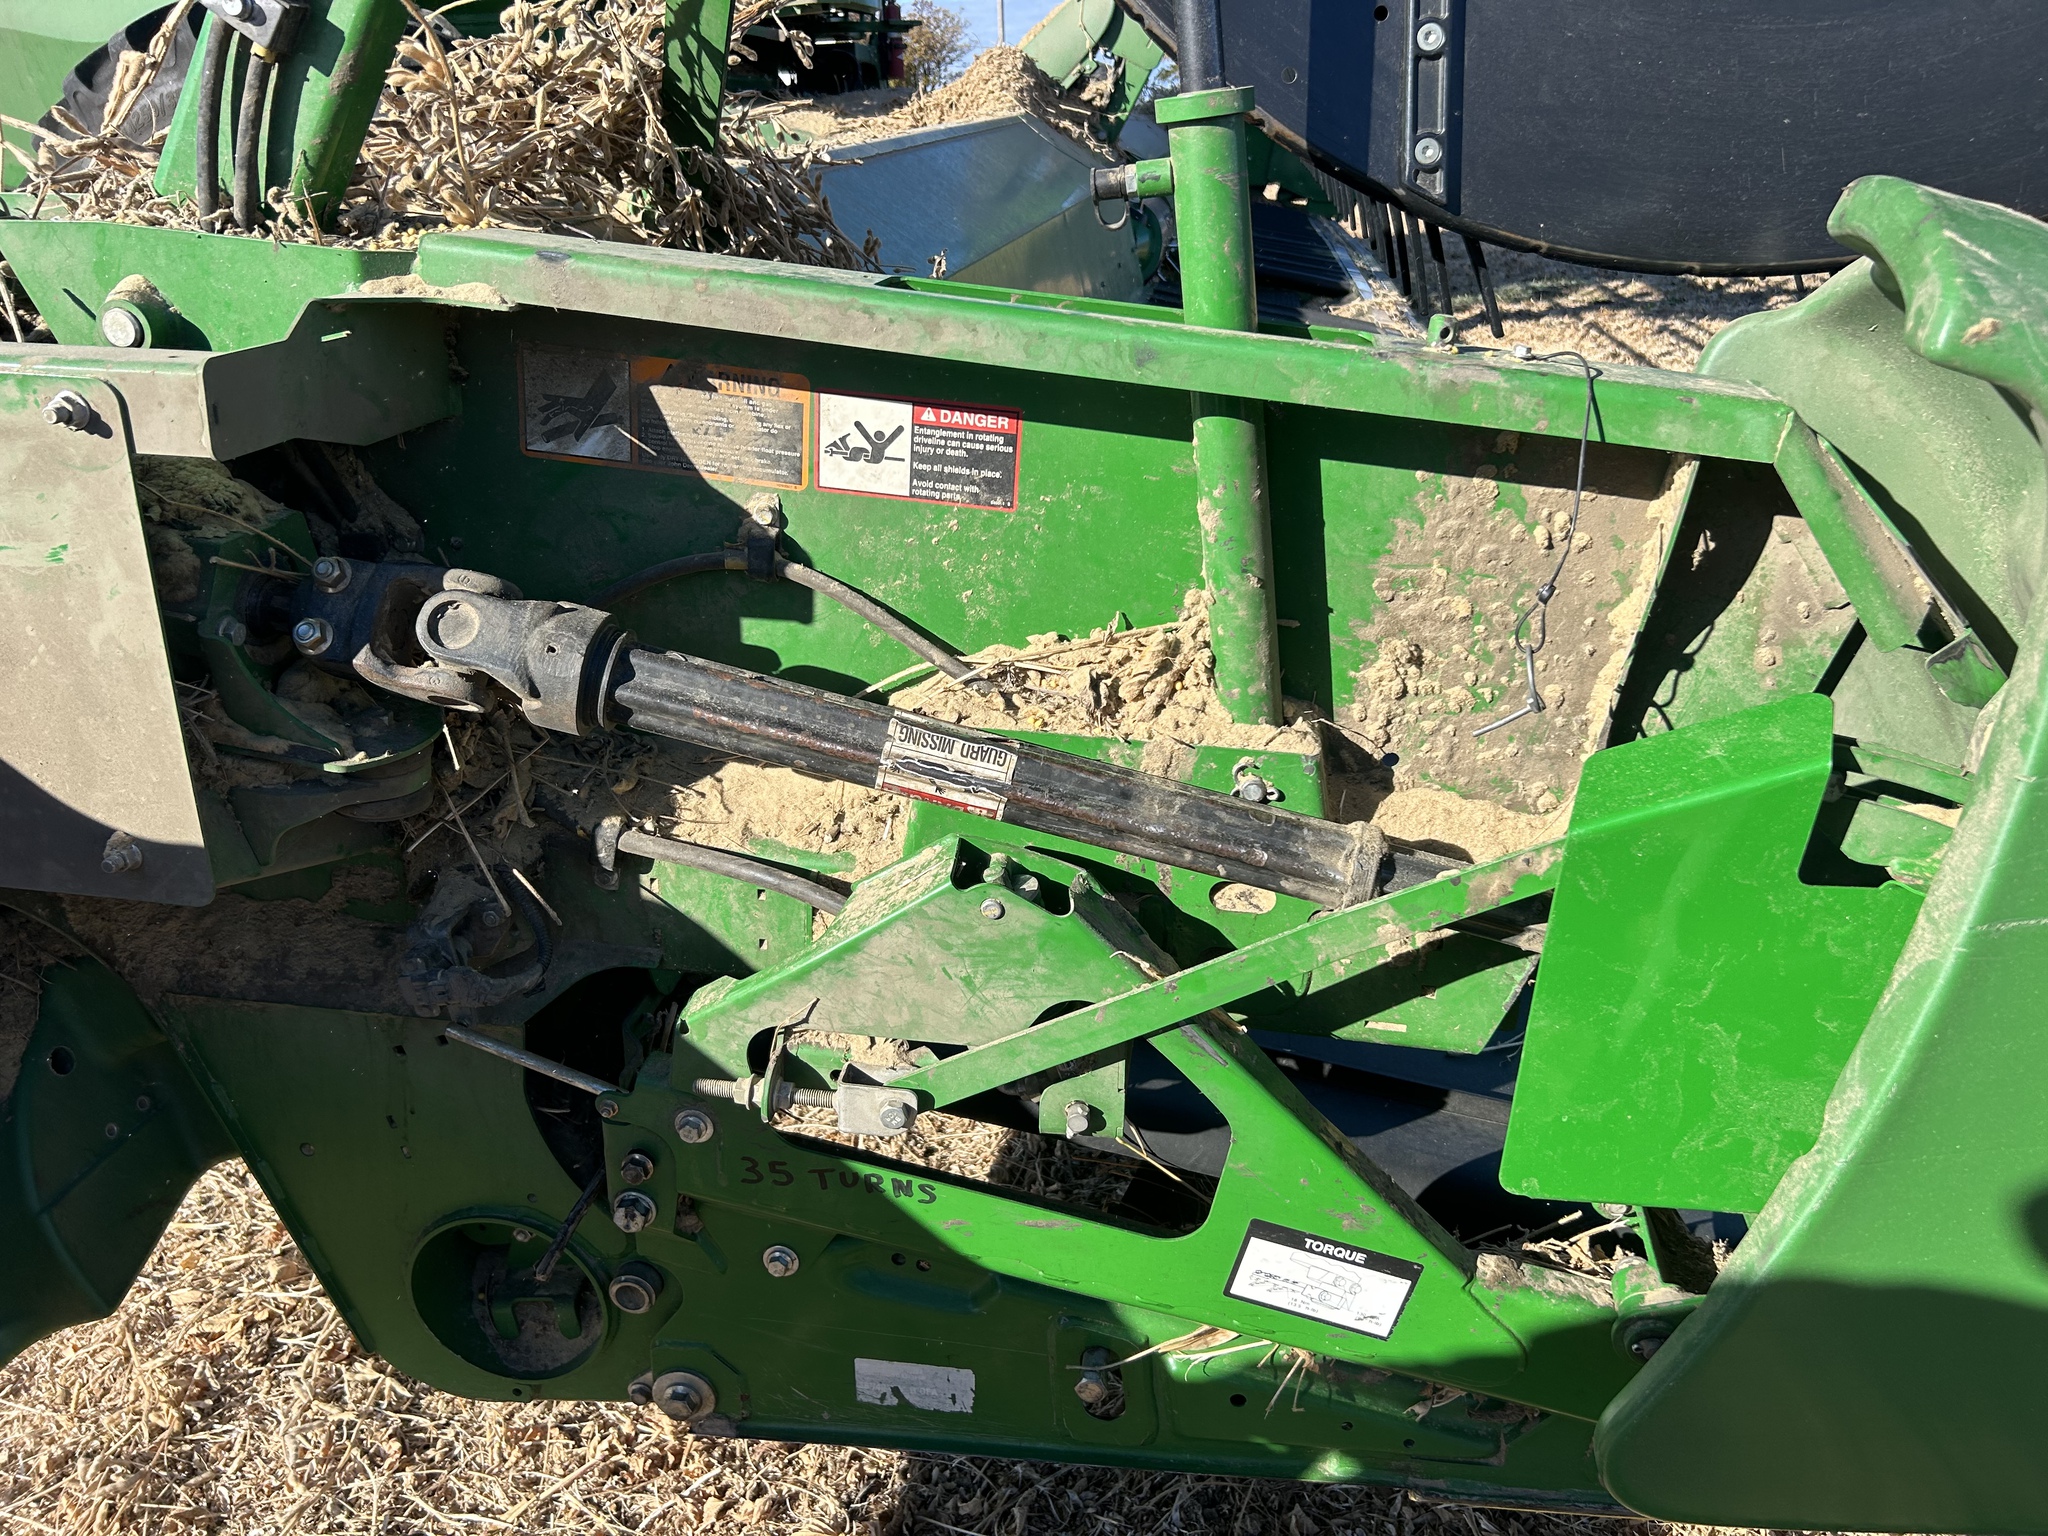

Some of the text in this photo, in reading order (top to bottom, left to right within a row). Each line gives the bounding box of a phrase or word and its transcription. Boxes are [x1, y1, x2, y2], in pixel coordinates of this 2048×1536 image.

[717, 371, 781, 397] RNING
[940, 409, 1010, 430] DANGER
[914, 426, 1004, 444] Entanglement in rotating
[913, 436, 1014, 453] driveline can cause serious
[913, 444, 934, 456] injury
[946, 448, 969, 458] death.
[912, 462, 932, 472] Keep
[933, 464, 942, 472] all
[944, 464, 970, 476] shields
[972, 468, 979, 476] in
[912, 478, 980, 493] Avoid contact with
[912, 488, 940, 499] rotating
[899, 725, 1008, 767] GUARD MISSING
[740, 1156, 938, 1204] 35 TURNS
[1304, 1237, 1368, 1265] TORQUE
